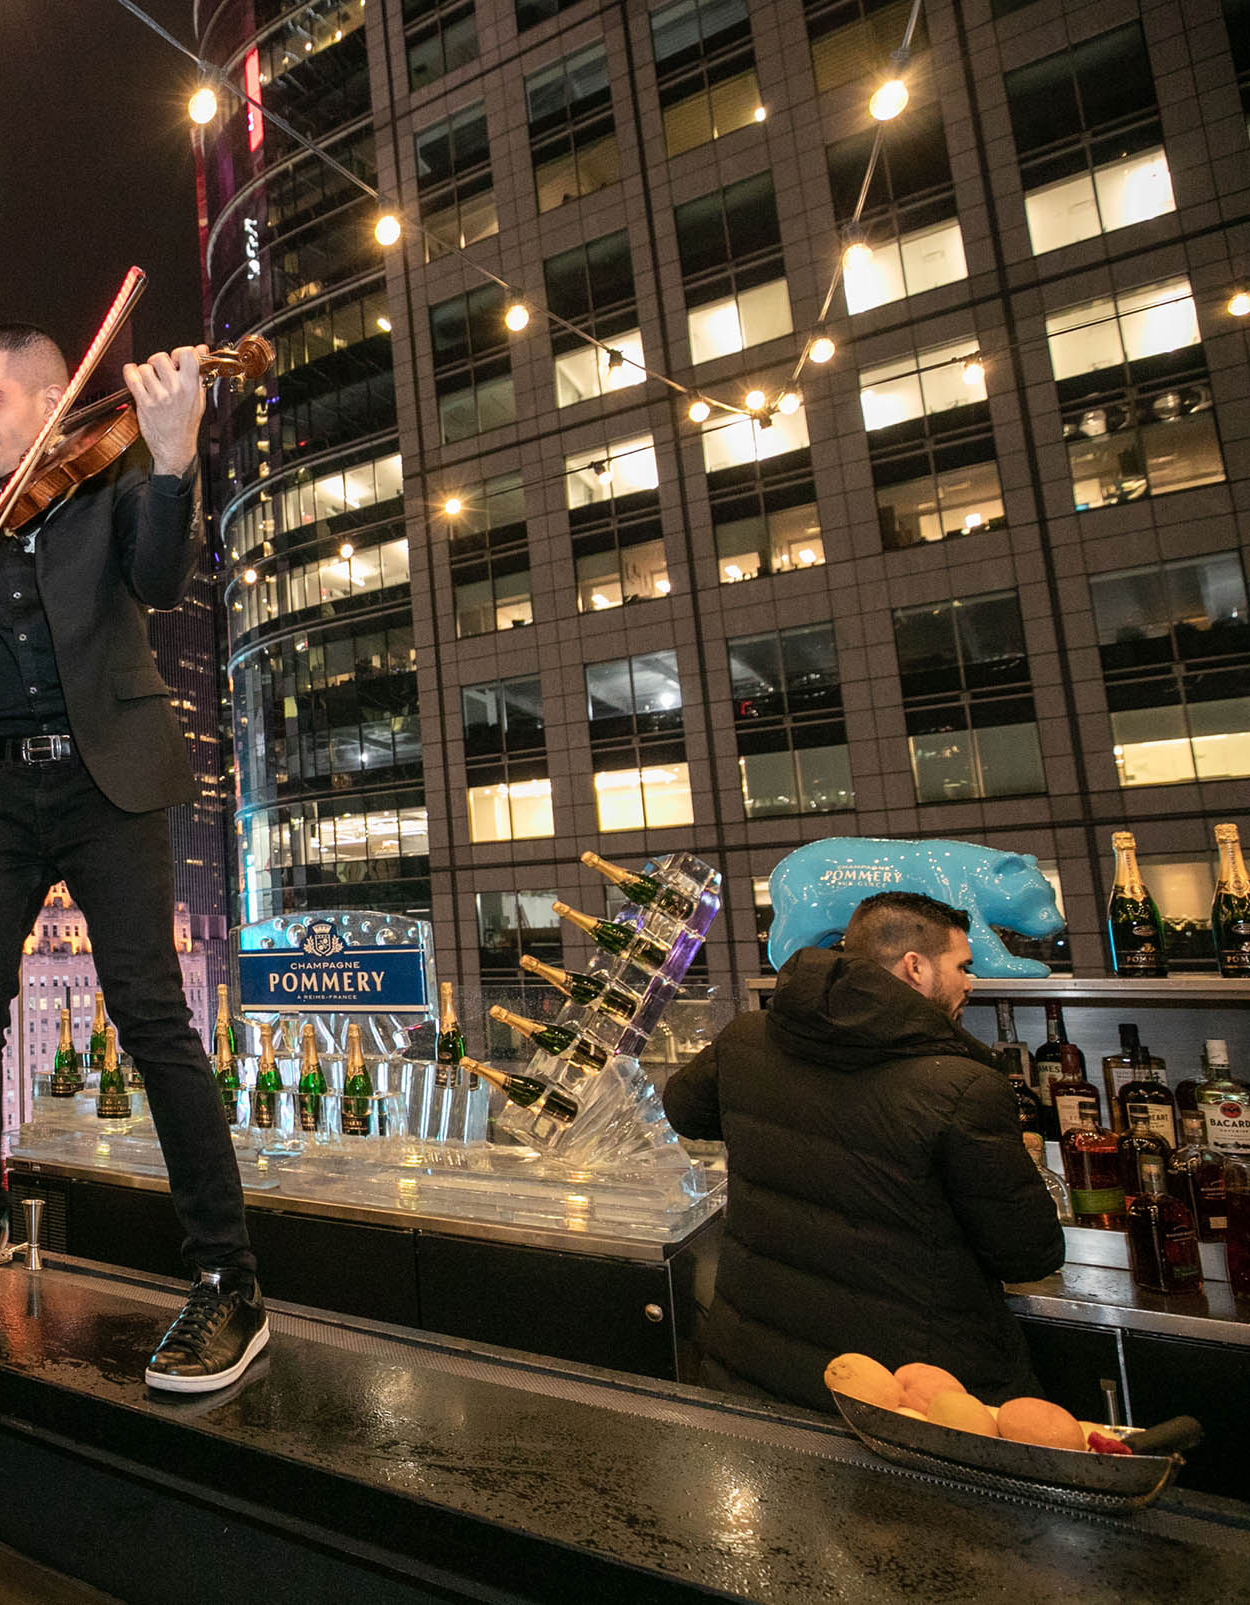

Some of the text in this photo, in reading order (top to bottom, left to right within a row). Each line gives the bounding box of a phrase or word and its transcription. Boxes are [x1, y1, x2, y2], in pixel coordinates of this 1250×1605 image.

[823, 870, 903, 884] POMMERY
[290, 961, 361, 970] CHAMPAGNE
[268, 971, 385, 992] POMMERY
